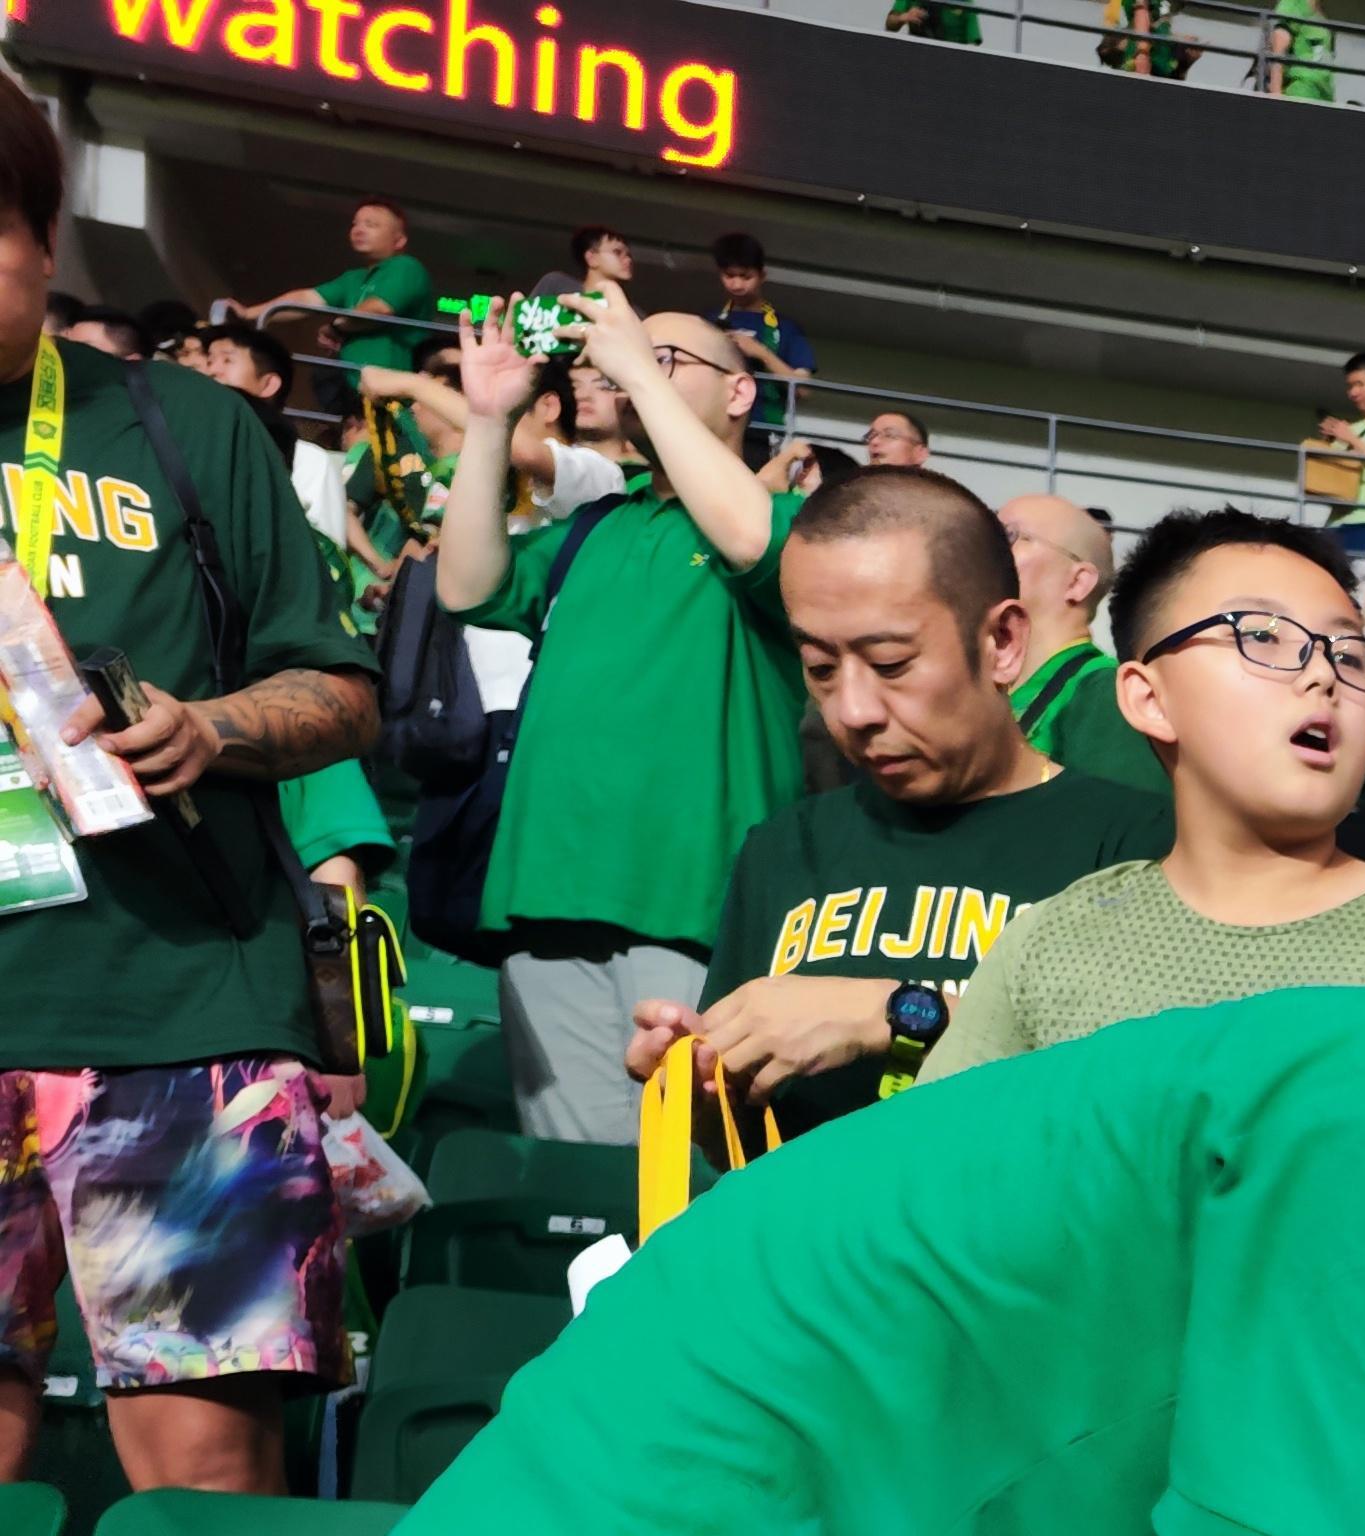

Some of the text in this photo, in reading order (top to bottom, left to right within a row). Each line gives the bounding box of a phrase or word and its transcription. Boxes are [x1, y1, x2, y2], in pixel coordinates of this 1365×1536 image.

[104, 0, 738, 170] watching
[0, 463, 158, 552] ING
[769, 885, 1032, 978] BEIJIN
